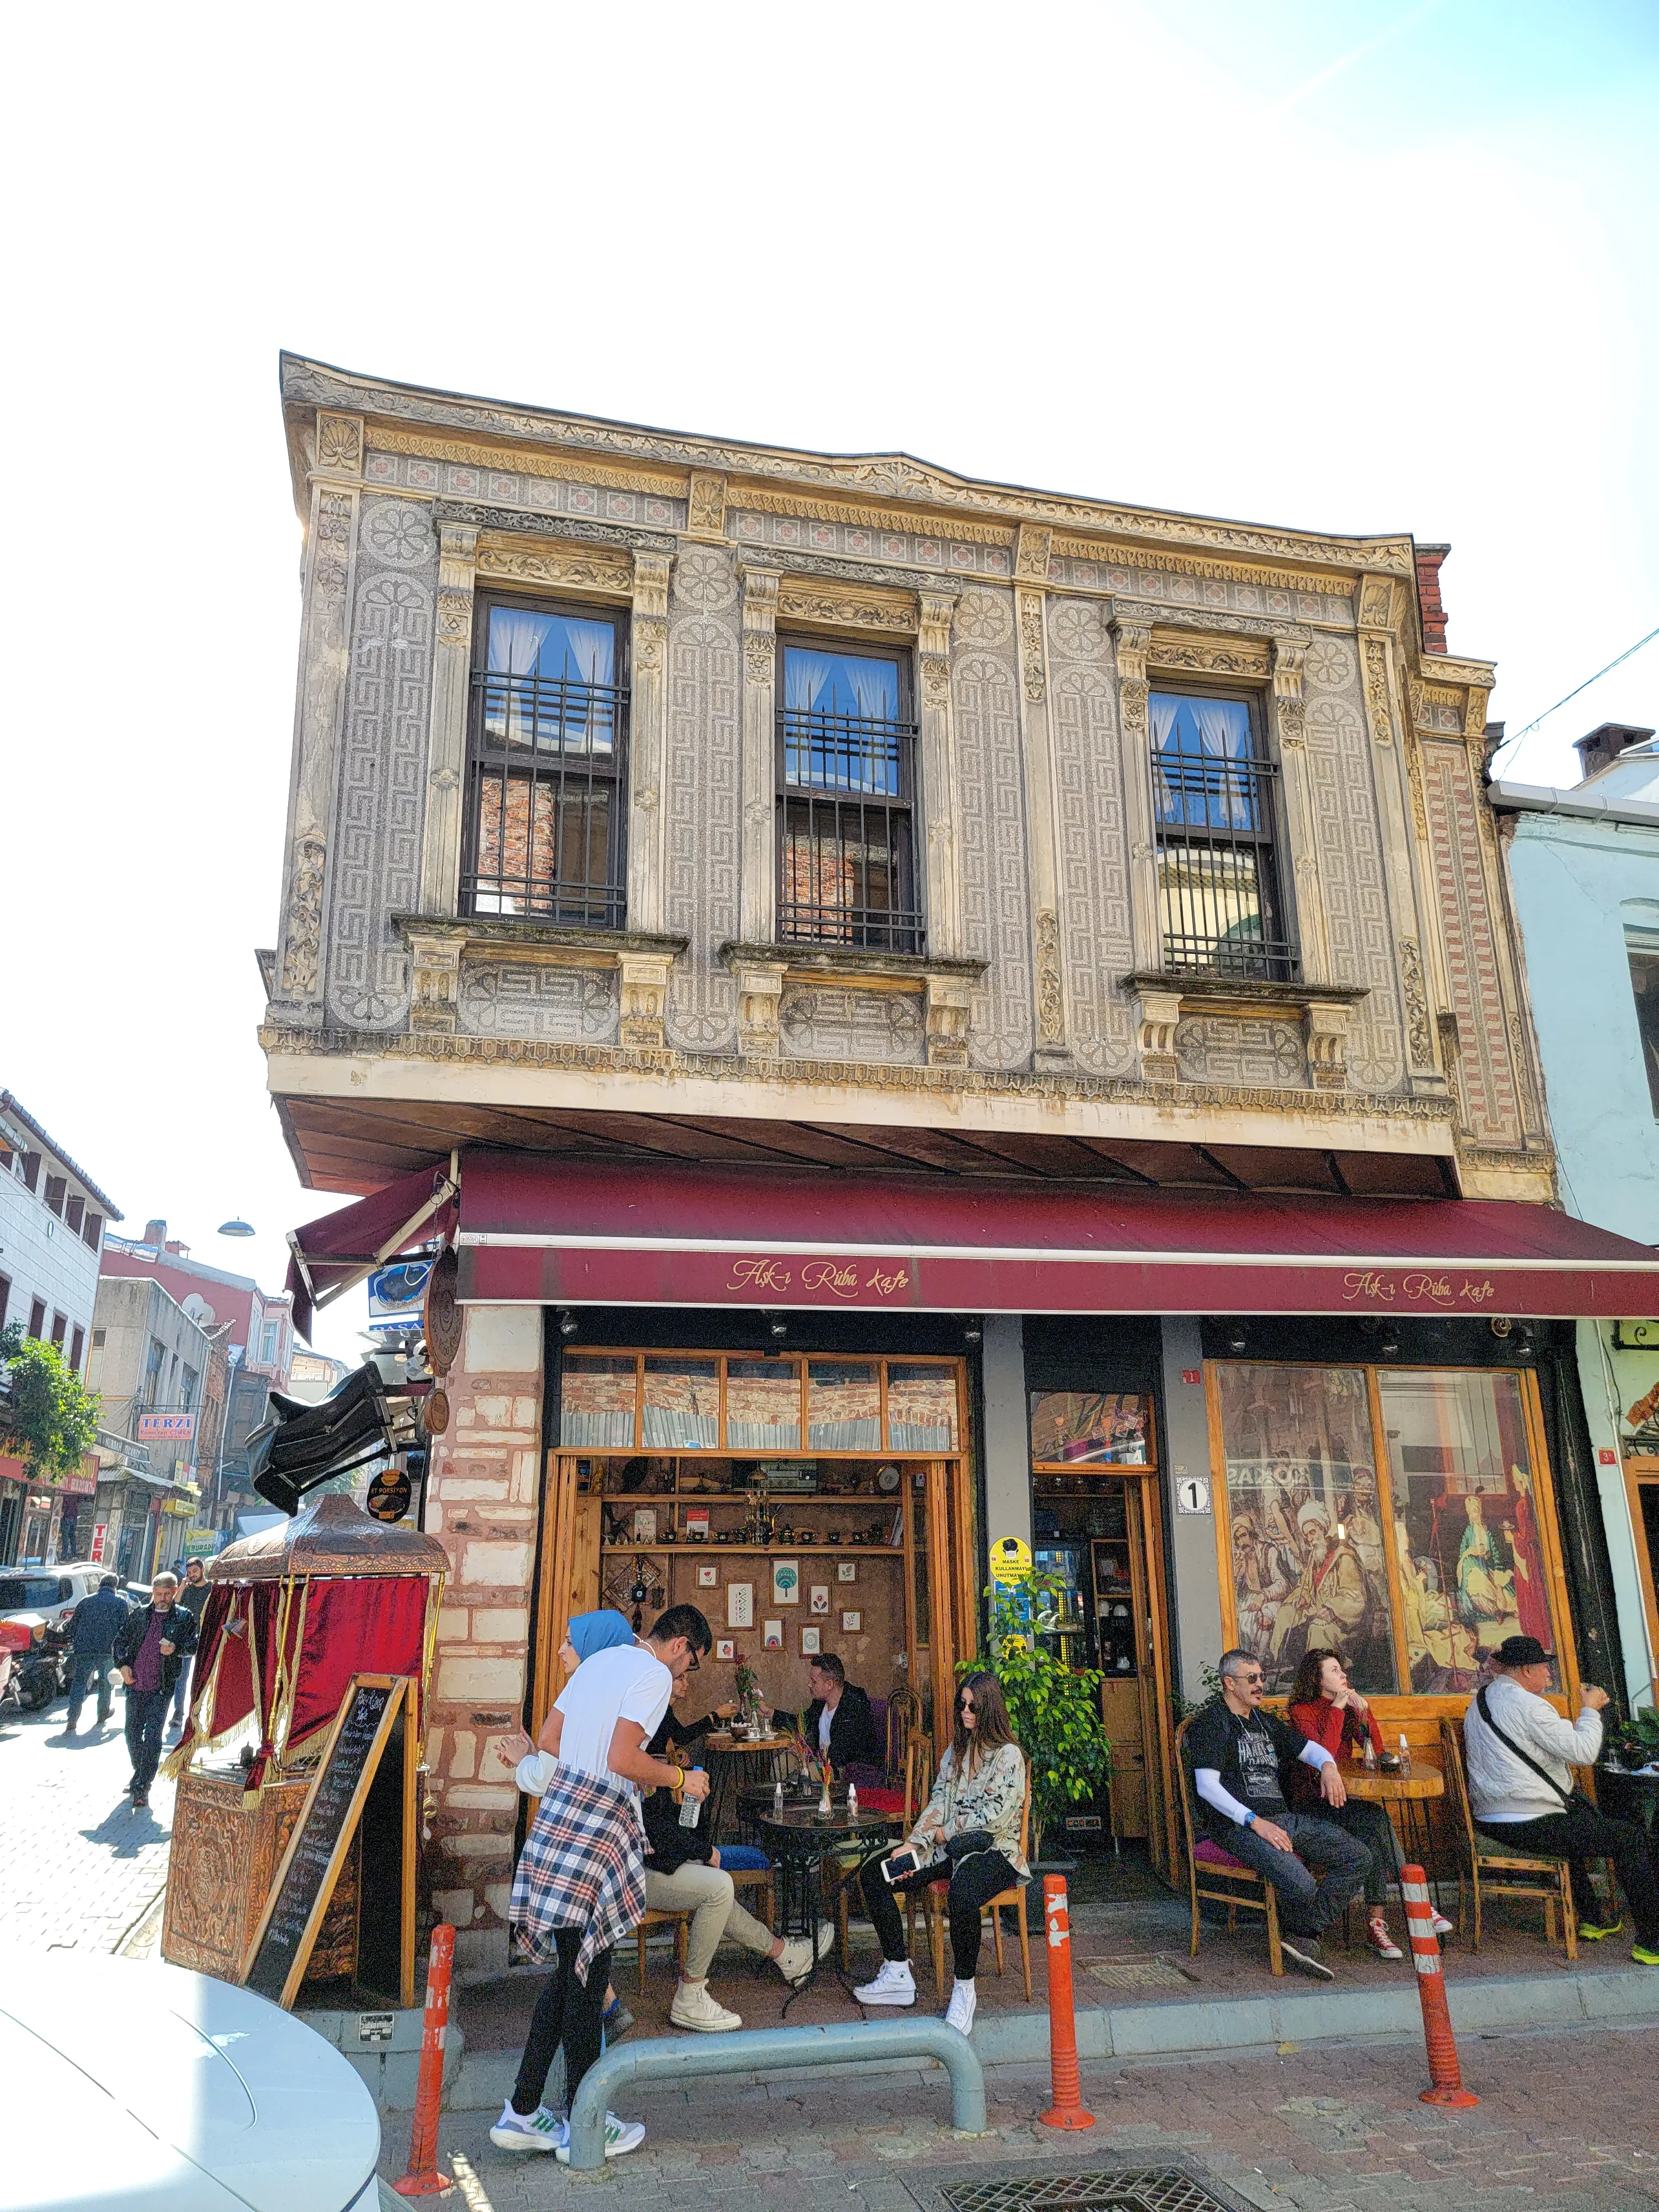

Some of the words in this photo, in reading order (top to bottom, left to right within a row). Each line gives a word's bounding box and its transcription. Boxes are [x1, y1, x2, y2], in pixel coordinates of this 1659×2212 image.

[726, 1259, 791, 1291] Aşk-ı
[143, 1416, 191, 1428] TERZİ
[1187, 1482, 1197, 1509] 1
